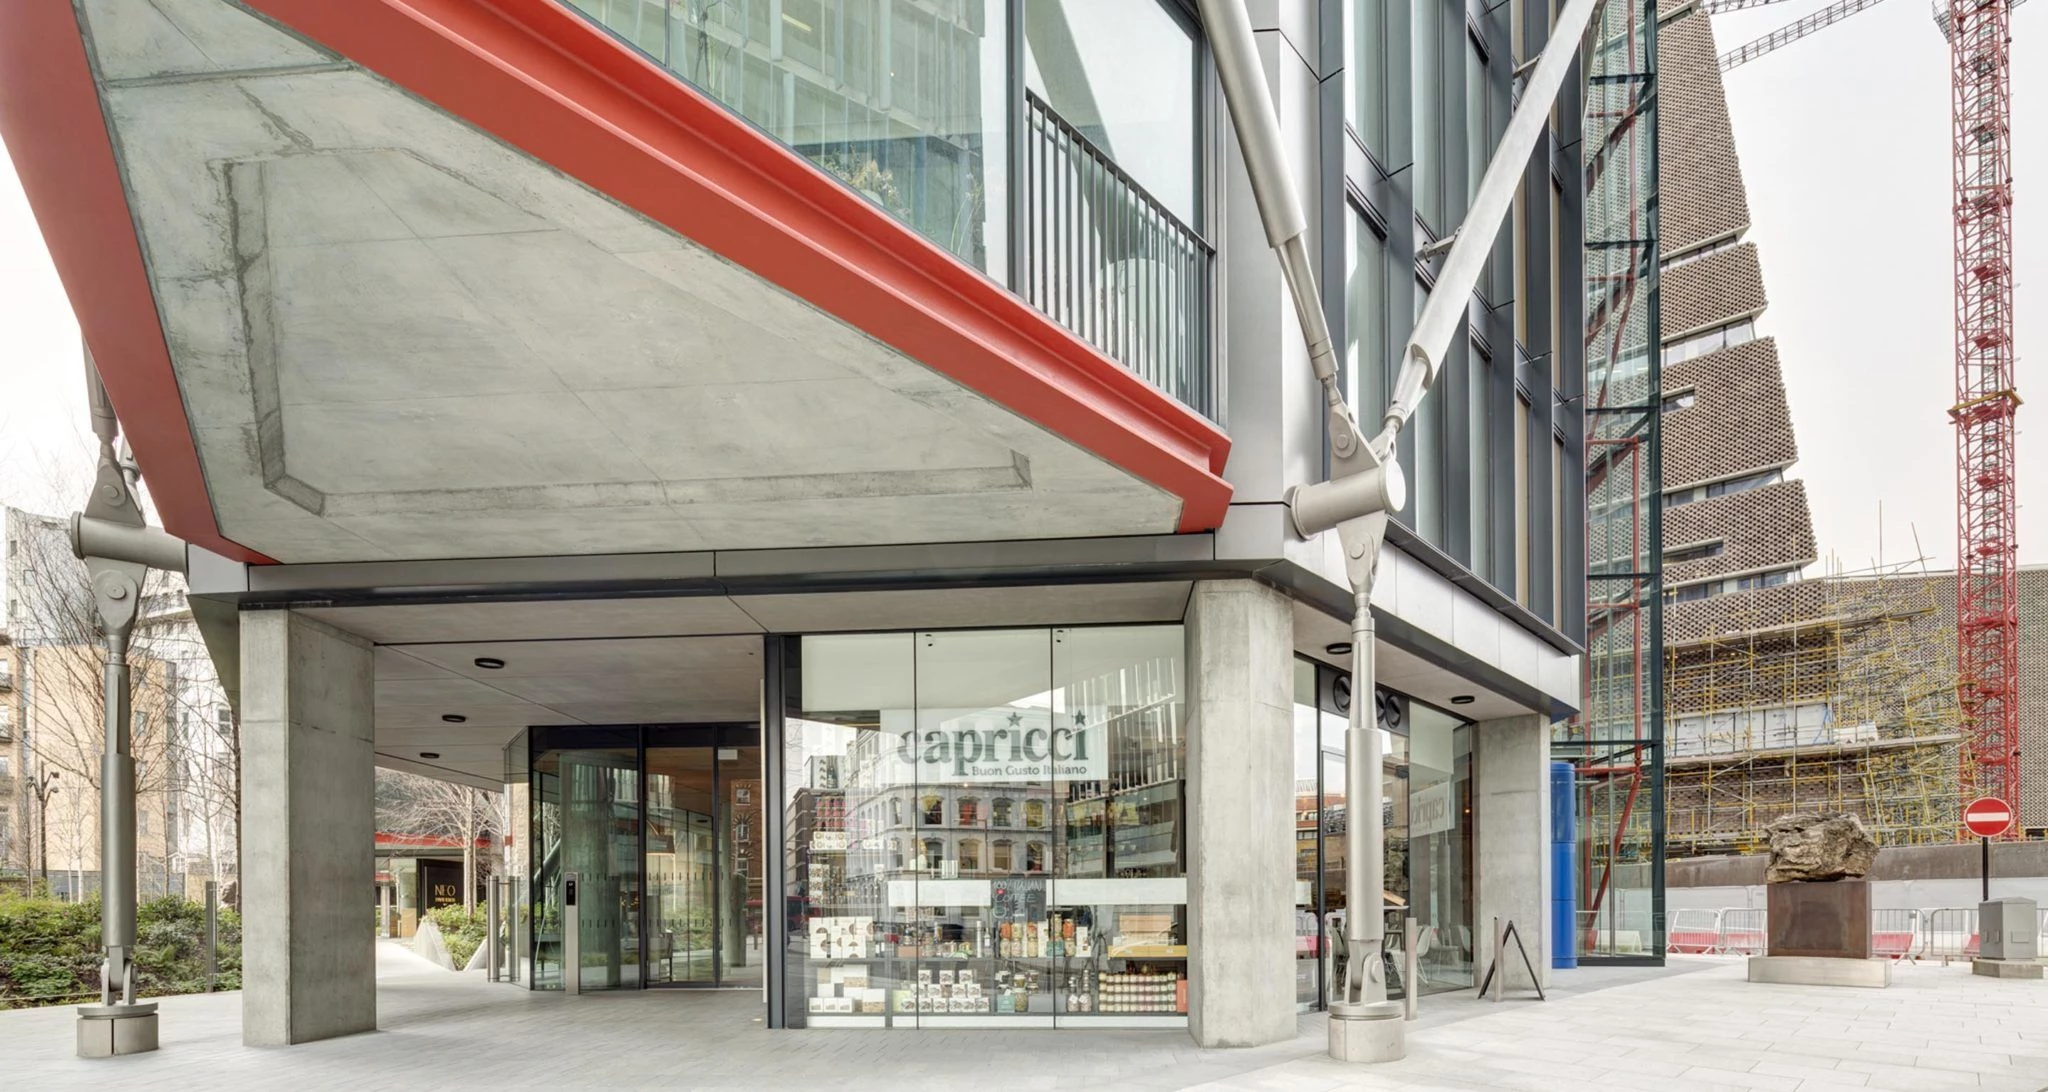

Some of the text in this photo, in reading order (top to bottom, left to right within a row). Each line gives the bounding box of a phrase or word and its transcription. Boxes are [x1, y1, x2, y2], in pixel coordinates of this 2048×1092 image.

[897, 709, 1089, 776] capricci
[972, 765, 1087, 776] Buon Gusto Italiano
